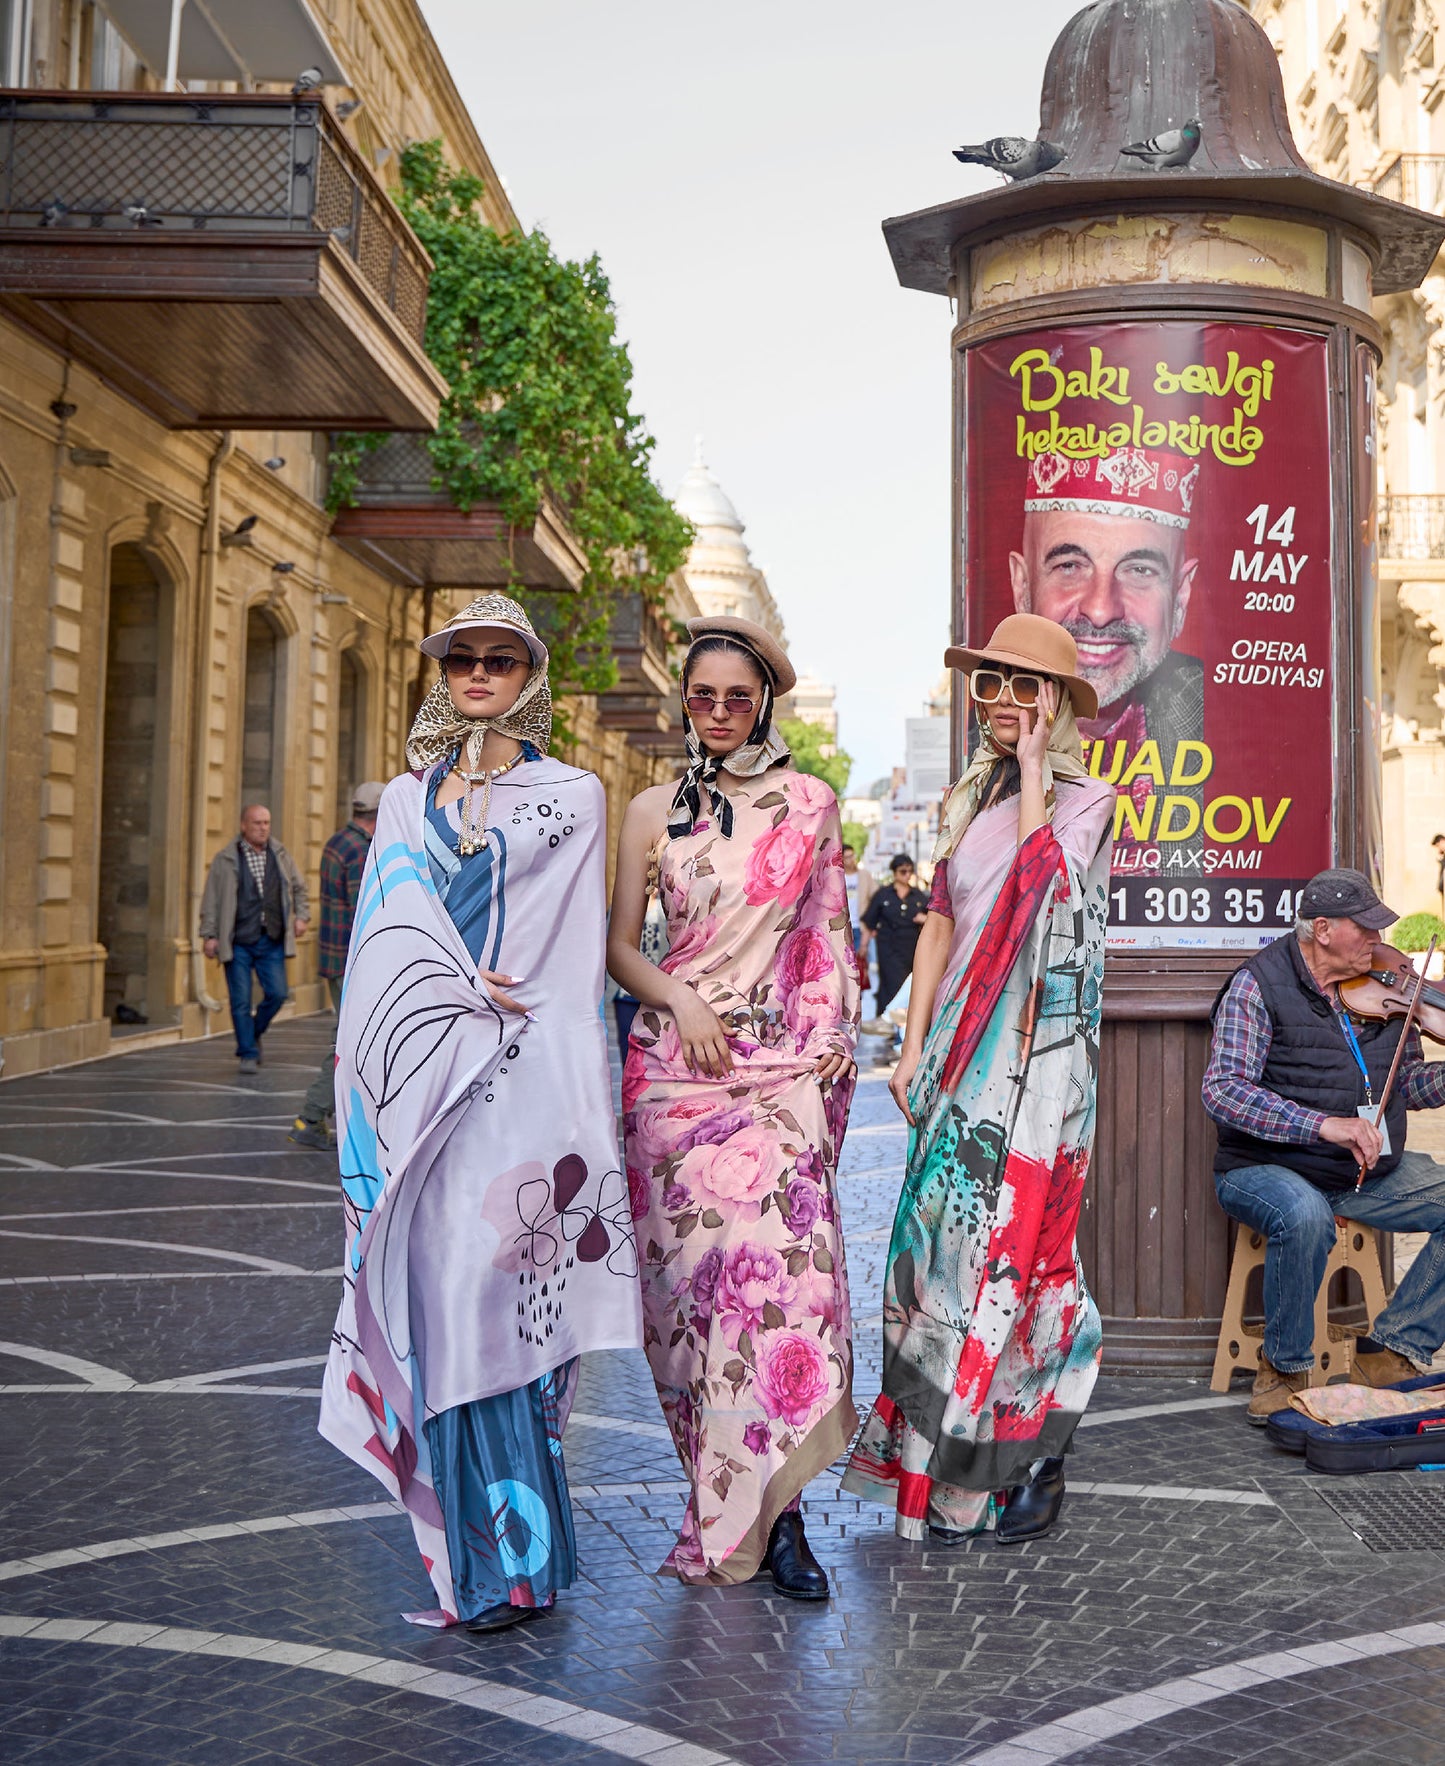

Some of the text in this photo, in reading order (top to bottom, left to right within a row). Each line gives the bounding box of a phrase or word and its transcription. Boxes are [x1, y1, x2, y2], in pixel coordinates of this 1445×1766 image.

[1009, 346, 1275, 418] Bakı sevgi
[1016, 404, 1264, 466] hekayələrində
[1245, 504, 1296, 547] 14
[1229, 550, 1309, 585] MAY
[1244, 591, 1295, 613] 20:00
[1231, 639, 1307, 663] OPERA
[1213, 663, 1324, 688] STUDIYASI
[1113, 795, 1292, 843] NDOV
[1112, 849, 1263, 873] ILIQ AXŞAMI
[1106, 887, 1127, 921] 1
[1144, 887, 1211, 923] 303
[1224, 888, 1265, 923] 35
